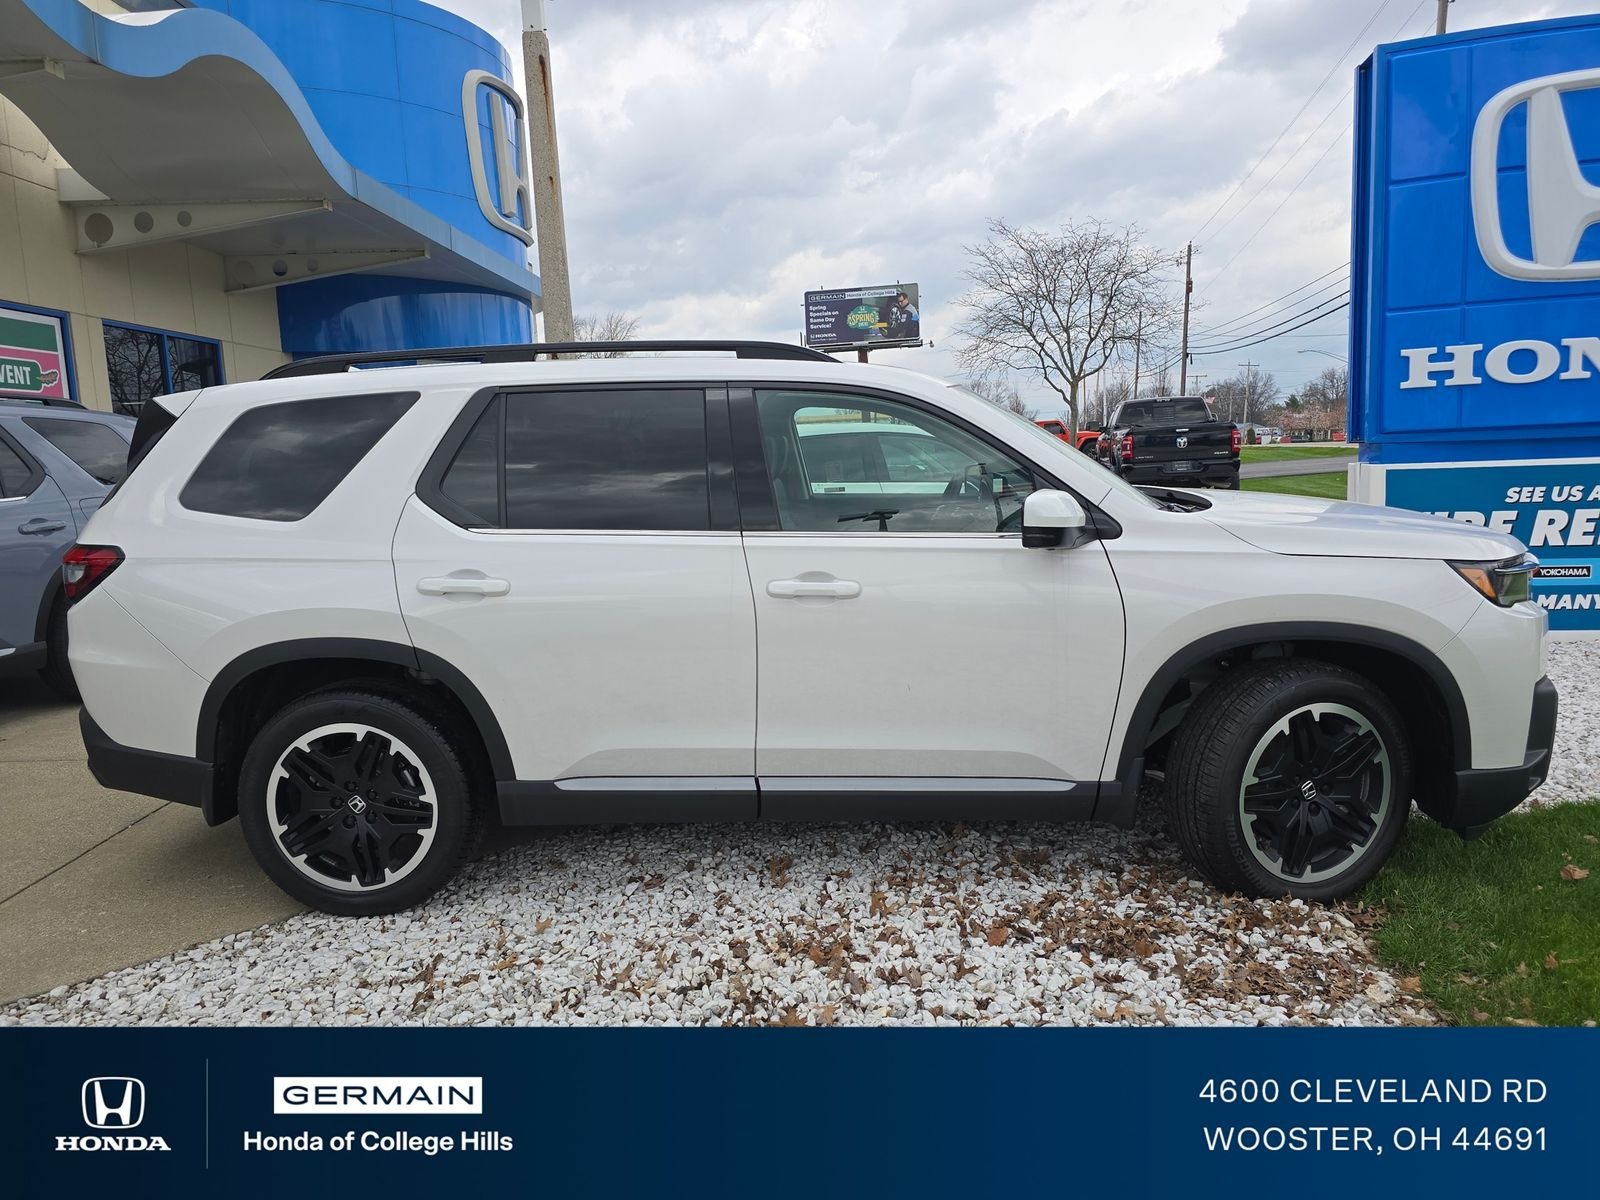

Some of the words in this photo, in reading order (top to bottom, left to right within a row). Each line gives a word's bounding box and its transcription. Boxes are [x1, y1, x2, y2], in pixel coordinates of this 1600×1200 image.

[1504, 486, 1547, 503] SEE
[1551, 485, 1585, 502] US
[1528, 509, 1600, 547] RE
[1540, 568, 1589, 576] YOKOHAMA
